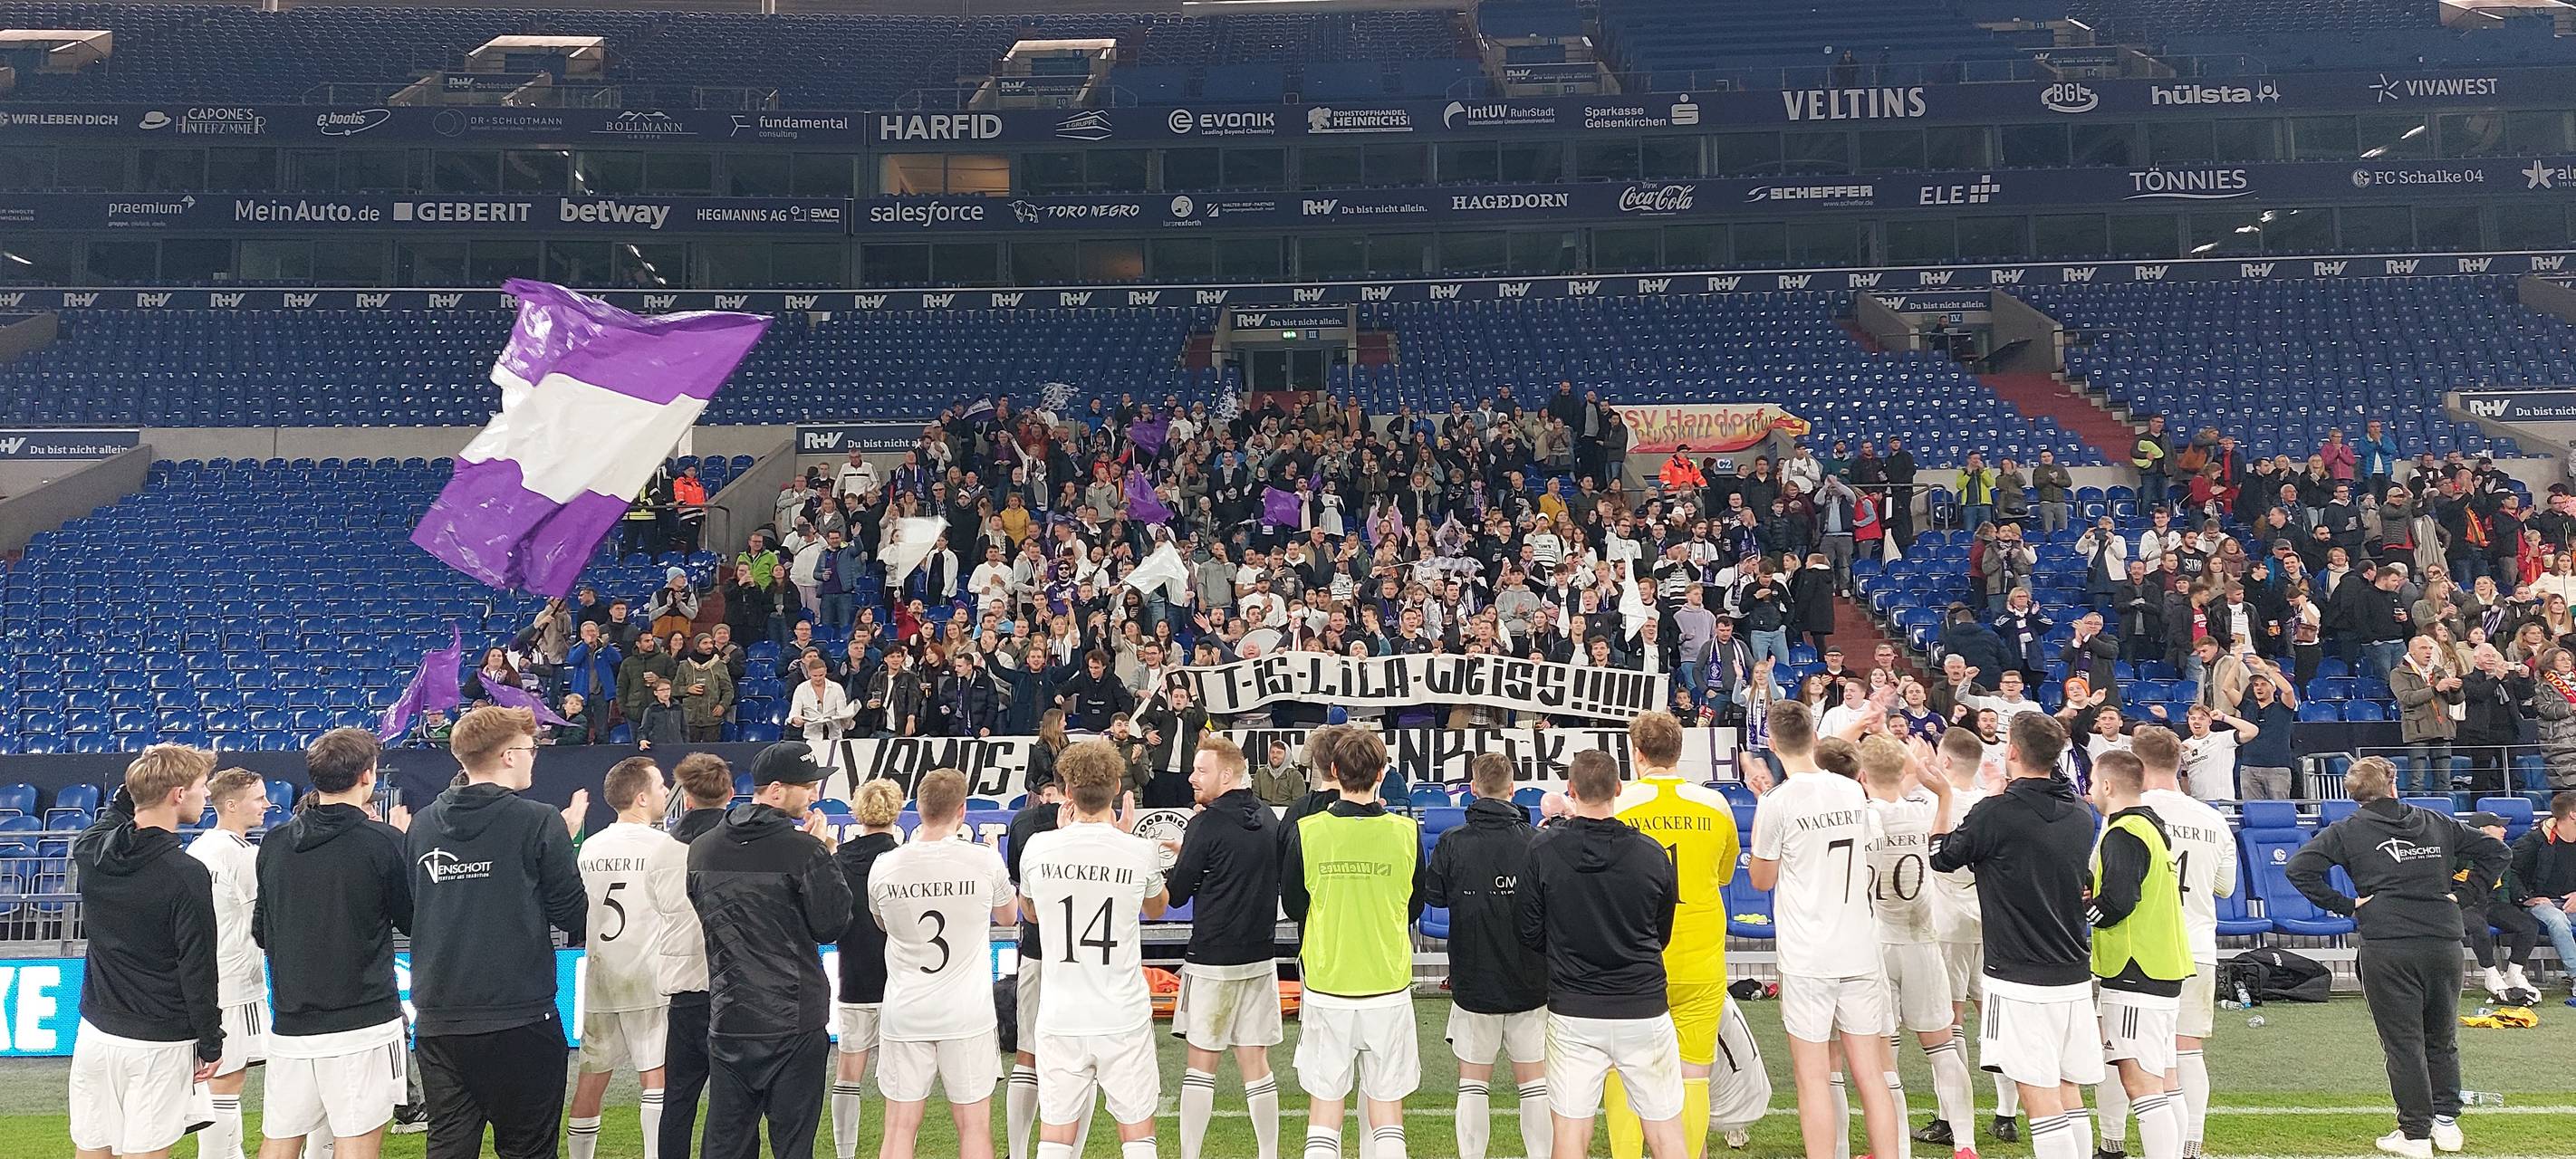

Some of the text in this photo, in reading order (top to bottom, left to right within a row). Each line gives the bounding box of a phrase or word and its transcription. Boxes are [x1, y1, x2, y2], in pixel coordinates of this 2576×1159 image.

[2052, 83, 2087, 102] BGL
[2151, 84, 2252, 105] hülsta
[2406, 78, 2498, 96] VIVAWEST
[1467, 105, 1555, 119] IntUV RuhrStadt
[1584, 106, 1645, 120] Sparkasse
[1783, 88, 1927, 120] VELTINS
[12, 115, 119, 125] WIR LEBEN DICH
[187, 108, 254, 120] CAPONE'S
[493, 117, 562, 125] SCHLOTMANN
[759, 115, 849, 129] fundamental
[1200, 112, 1275, 128] EVONIK
[1584, 117, 1668, 129] Gelsenkirchen
[606, 120, 683, 131] BOLLMANN
[759, 130, 798, 139] consulting
[880, 115, 1003, 139] HARFID
[2129, 168, 2247, 191] TÖNNIES
[2375, 169, 2485, 184] FC Schalke 04
[1452, 193, 1569, 211] HAGEDORN
[1771, 186, 1873, 200] SCHEFFER
[1920, 186, 1965, 205] ELE
[109, 202, 182, 217] praemium
[235, 200, 380, 223] MeinAuto.de
[418, 203, 533, 223] GEBERIT
[560, 198, 671, 230] betway
[697, 208, 787, 222] HEGMANNS AG
[870, 201, 984, 227] salesforce
[1048, 205, 1140, 219] TORO NEGRO
[1302, 199, 1427, 215] R+V Du bist nicht allein.
[63, 293, 99, 307] R+V
[137, 293, 172, 307] R+V
[210, 293, 245, 308] R+V
[284, 293, 318, 308] R+V
[356, 293, 390, 308] R+V
[428, 293, 463, 308] R+V
[644, 294, 678, 309] R+V
[715, 294, 748, 309] R+V
[785, 294, 818, 309] R+V
[855, 294, 887, 309] R+V
[923, 293, 955, 309] R+V
[992, 292, 1024, 308] R+V
[1061, 292, 1092, 306] R+V
[1129, 291, 1161, 305] R+V
[1197, 290, 1228, 304] R+V
[1293, 288, 1325, 302] R+V
[1361, 286, 1394, 301] R+V
[1430, 283, 1463, 299] R+V
[1499, 283, 1532, 297] R+V
[1568, 281, 1601, 295] R+V
[1639, 278, 1671, 293] R+V
[1708, 276, 1741, 292] R+V
[1778, 274, 1812, 290] R+V
[1849, 273, 1882, 288] R+V
[1920, 271, 1954, 286] R+V
[1992, 269, 2025, 284] R+V
[2063, 267, 2097, 283] R+V
[2136, 265, 2169, 281] R+V
[2241, 263, 2274, 278] R+V
[2313, 261, 2347, 276] R+V
[2386, 259, 2419, 274] R+V
[2458, 257, 2492, 273] R+V
[2532, 255, 2565, 271] R+V
[1237, 314, 1266, 327] R+V
[1950, 313, 1962, 322] IV
[2469, 399, 2576, 417] R+V Du bist nich
[1666, 407, 1769, 429] Handorf
[0, 437, 26, 455] +V
[30, 445, 44, 455] Du
[47, 445, 66, 454] bist
[70, 444, 95, 454] nicht
[804, 432, 909, 449] R+V Du bist nicht
[1717, 458, 1732, 469] C2
[1629, 816, 1711, 831] WACKER III
[1796, 810, 1853, 832] WACKER
[2205, 827, 2216, 843] III
[424, 858, 494, 884] VENSCHOTT
[580, 857, 631, 873] WACKER
[1041, 862, 1134, 885] WACKER III
[1827, 838, 1854, 905] 7
[887, 881, 976, 899] WACKER III
[600, 882, 627, 942] 5
[1059, 896, 1118, 966] 14
[918, 910, 950, 974] 3
